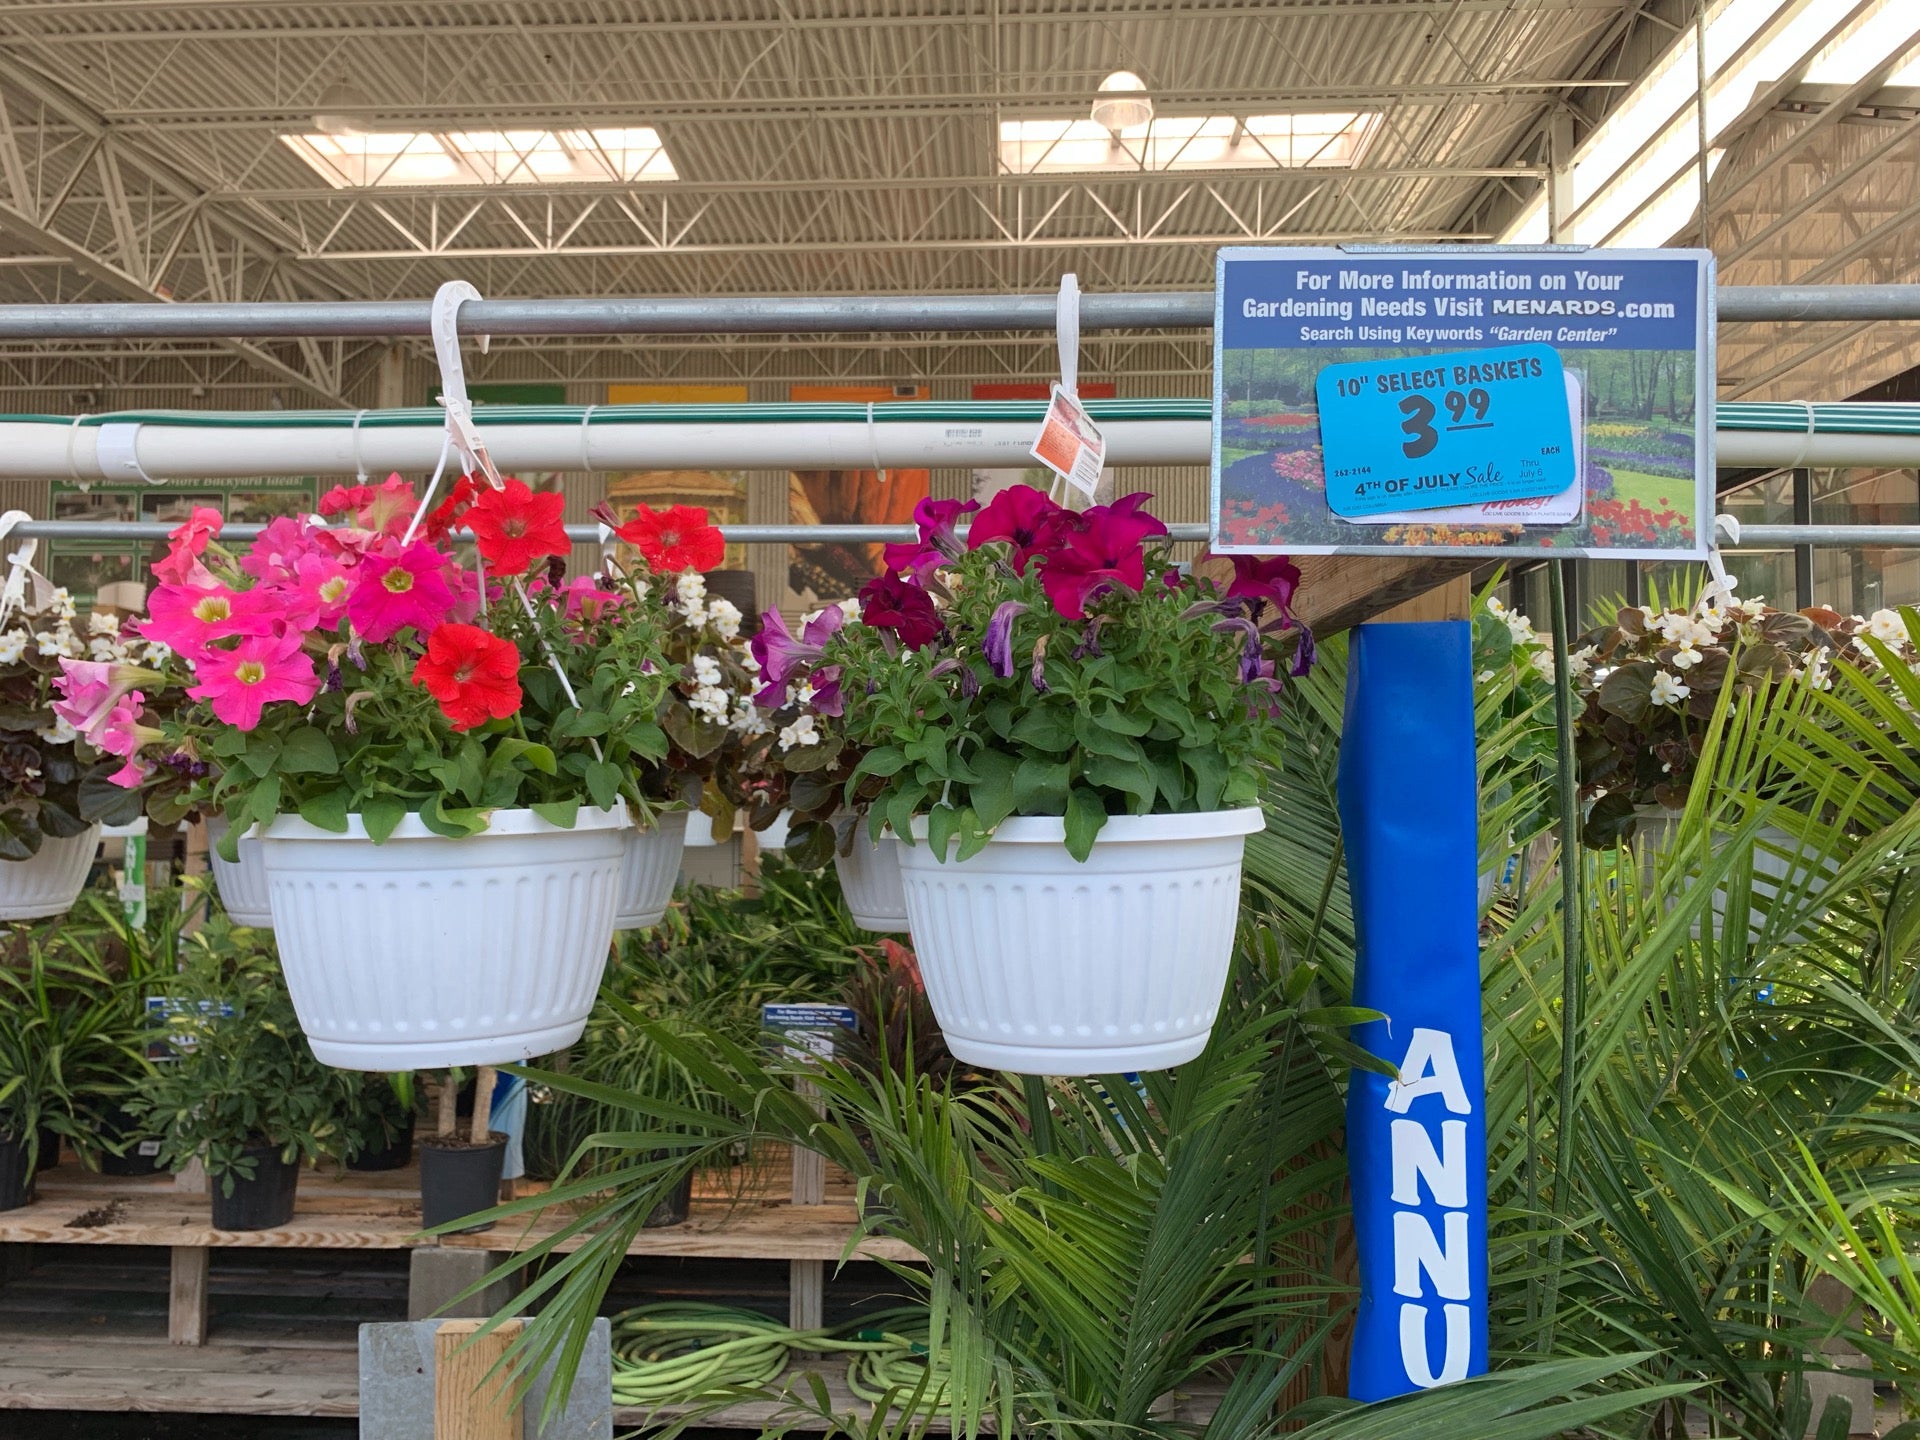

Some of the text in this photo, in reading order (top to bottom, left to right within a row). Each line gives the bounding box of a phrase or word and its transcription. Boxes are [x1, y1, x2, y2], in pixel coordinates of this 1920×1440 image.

[1296, 270, 1624, 291] For More Information on Your
[1243, 298, 1353, 321] Gardening
[1361, 298, 1427, 317] Needs
[1434, 298, 1484, 317] Visit
[1300, 326, 1618, 343] Search Using Keywords “Garden Center”
[1376, 367, 1446, 394] SELECT
[1453, 357, 1543, 387] BASKETS
[1541, 446, 1561, 456] EACH
[1521, 460, 1540, 468] Thru
[1354, 481, 1381, 496] 4TH
[1384, 478, 1409, 493] OF
[1413, 472, 1461, 490] JULY
[1464, 461, 1504, 485] Sale
[1519, 471, 1535, 479] July
[1384, 1027, 1472, 1389] ANNU
